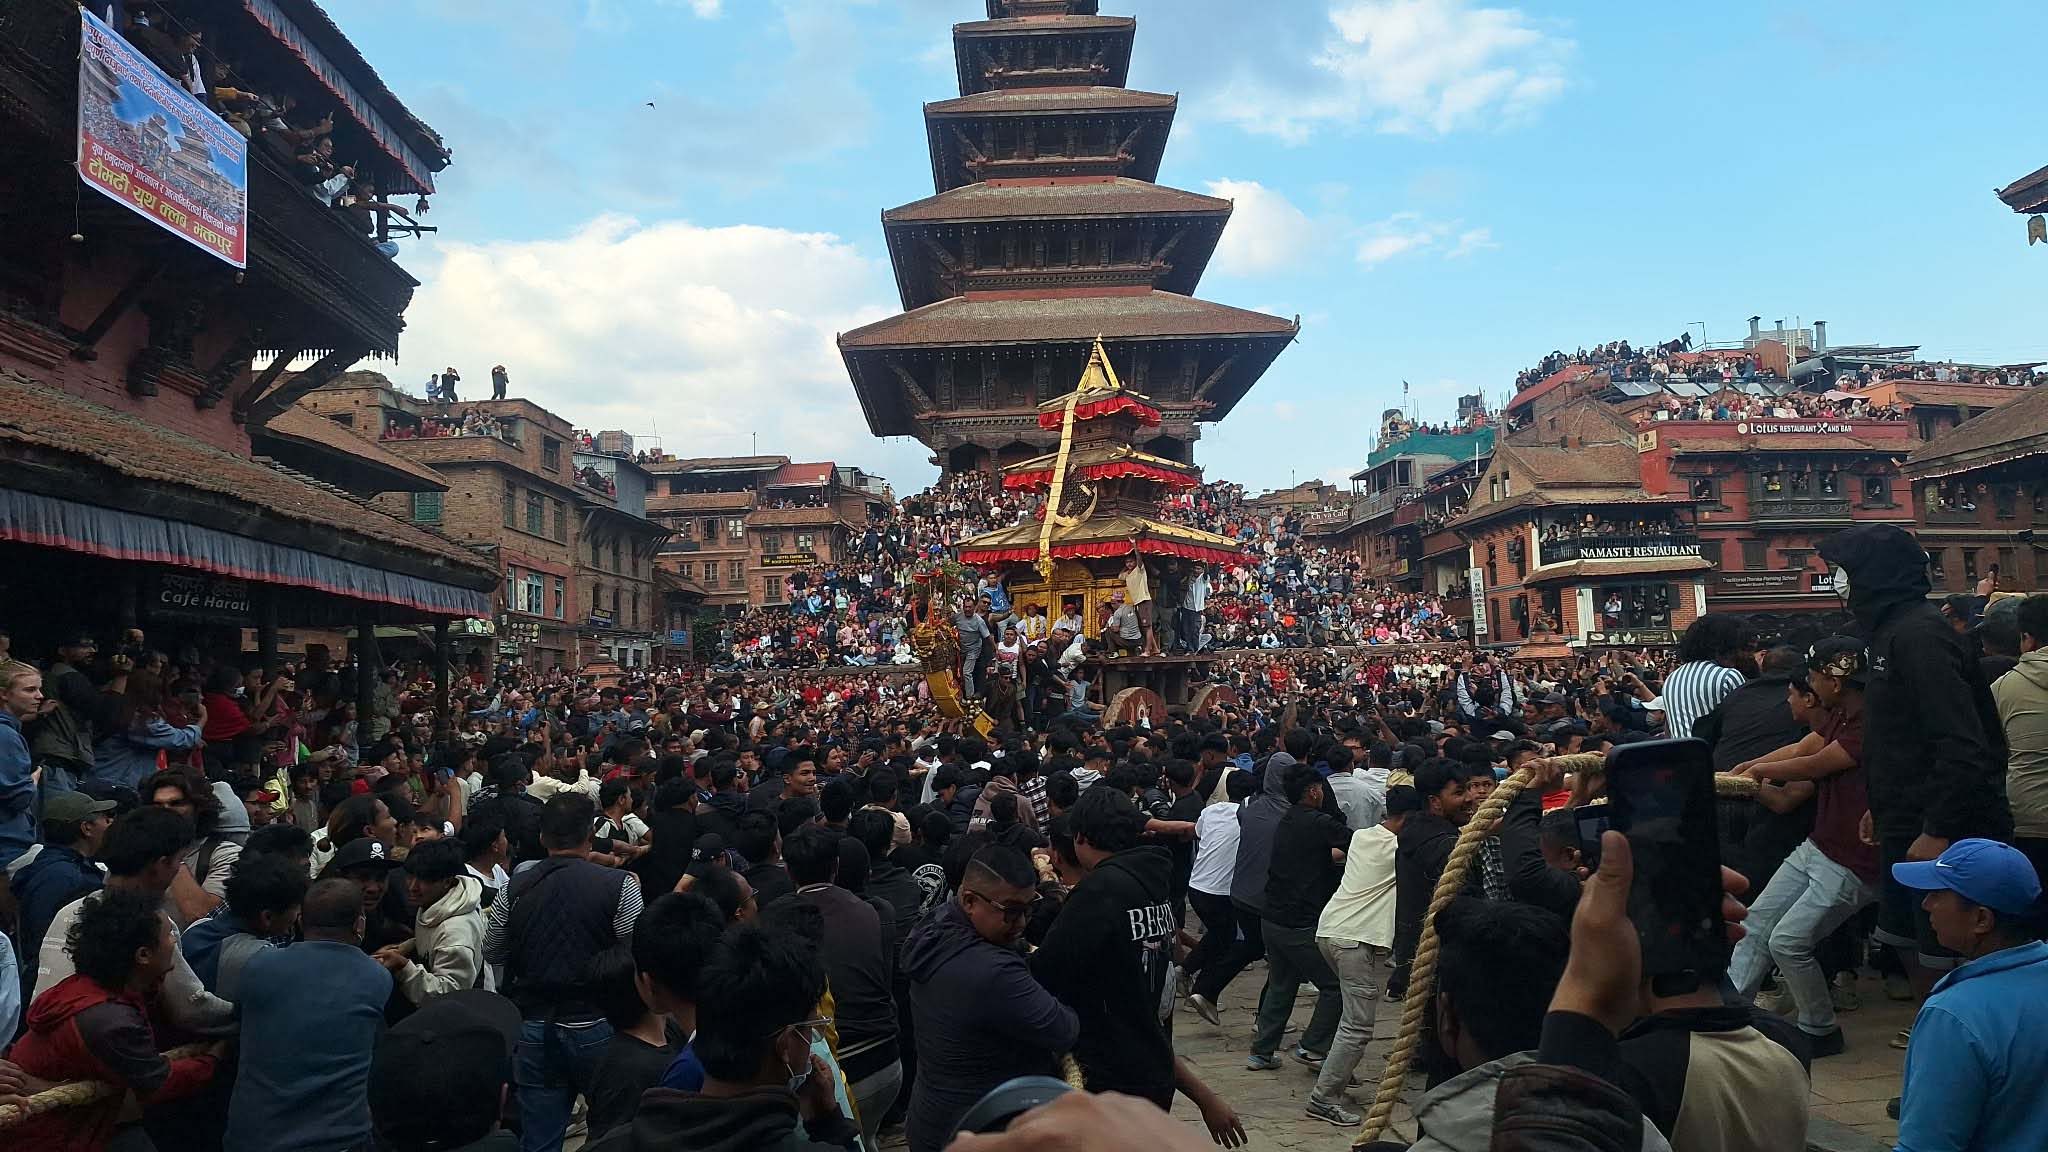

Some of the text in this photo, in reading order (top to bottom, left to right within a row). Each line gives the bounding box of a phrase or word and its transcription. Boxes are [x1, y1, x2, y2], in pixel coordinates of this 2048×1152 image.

[88, 151, 128, 196] टौमढी
[193, 218, 233, 257] भक्तपुर
[1750, 422, 1852, 434] Lotus RESTAURANT AND BAR
[1579, 545, 1701, 558] NAMASTE RESTAURANT
[1818, 575, 1835, 584] Lot
[1474, 582, 1483, 619] NAMASTE
